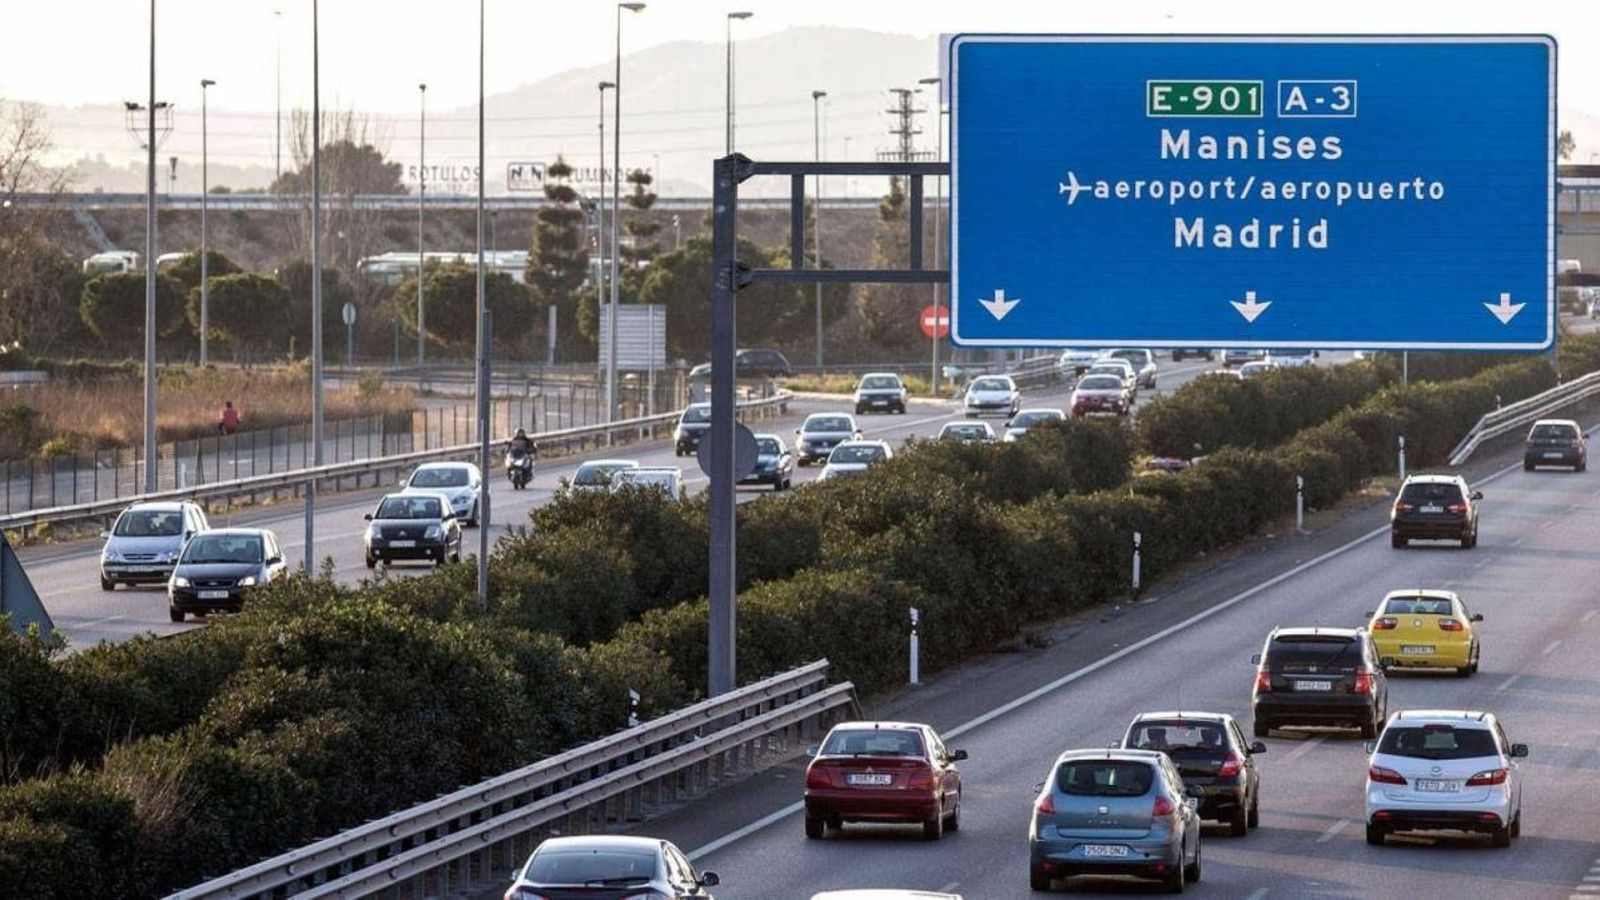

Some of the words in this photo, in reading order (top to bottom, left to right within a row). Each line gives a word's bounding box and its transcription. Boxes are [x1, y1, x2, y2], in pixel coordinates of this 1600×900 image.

[1153, 86, 1257, 111] E-901
[1285, 86, 1350, 111] A-3
[1161, 129, 1342, 160] Manises
[1094, 176, 1444, 206] aeroport/aeropuerto
[1175, 217, 1328, 249] Madrid
